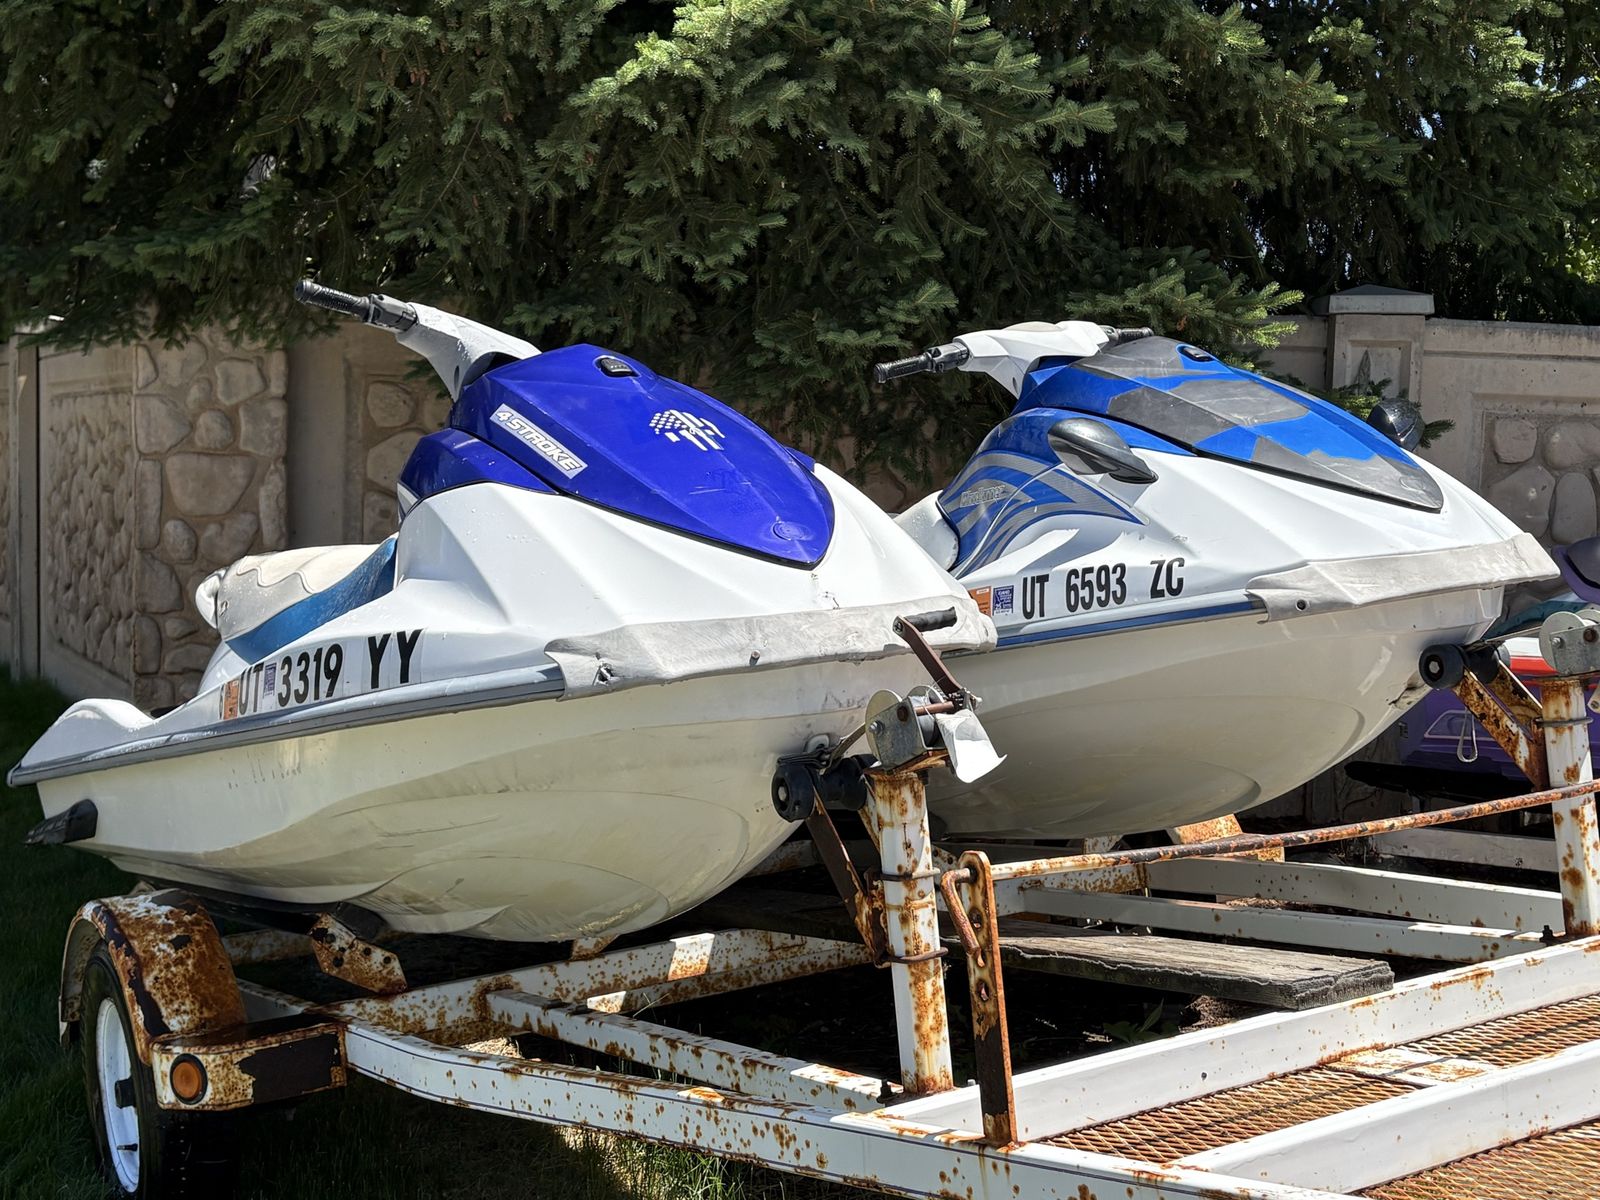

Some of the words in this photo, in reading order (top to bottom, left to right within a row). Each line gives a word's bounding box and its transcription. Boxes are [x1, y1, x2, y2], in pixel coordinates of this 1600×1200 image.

[496, 411, 512, 423] 4
[505, 417, 581, 471] STROKE
[1022, 574, 1049, 619] UT
[1065, 562, 1127, 612] 6593
[1149, 557, 1185, 599] ZC
[239, 662, 264, 715] UT
[278, 644, 343, 707] 3319
[367, 628, 423, 689] YY
